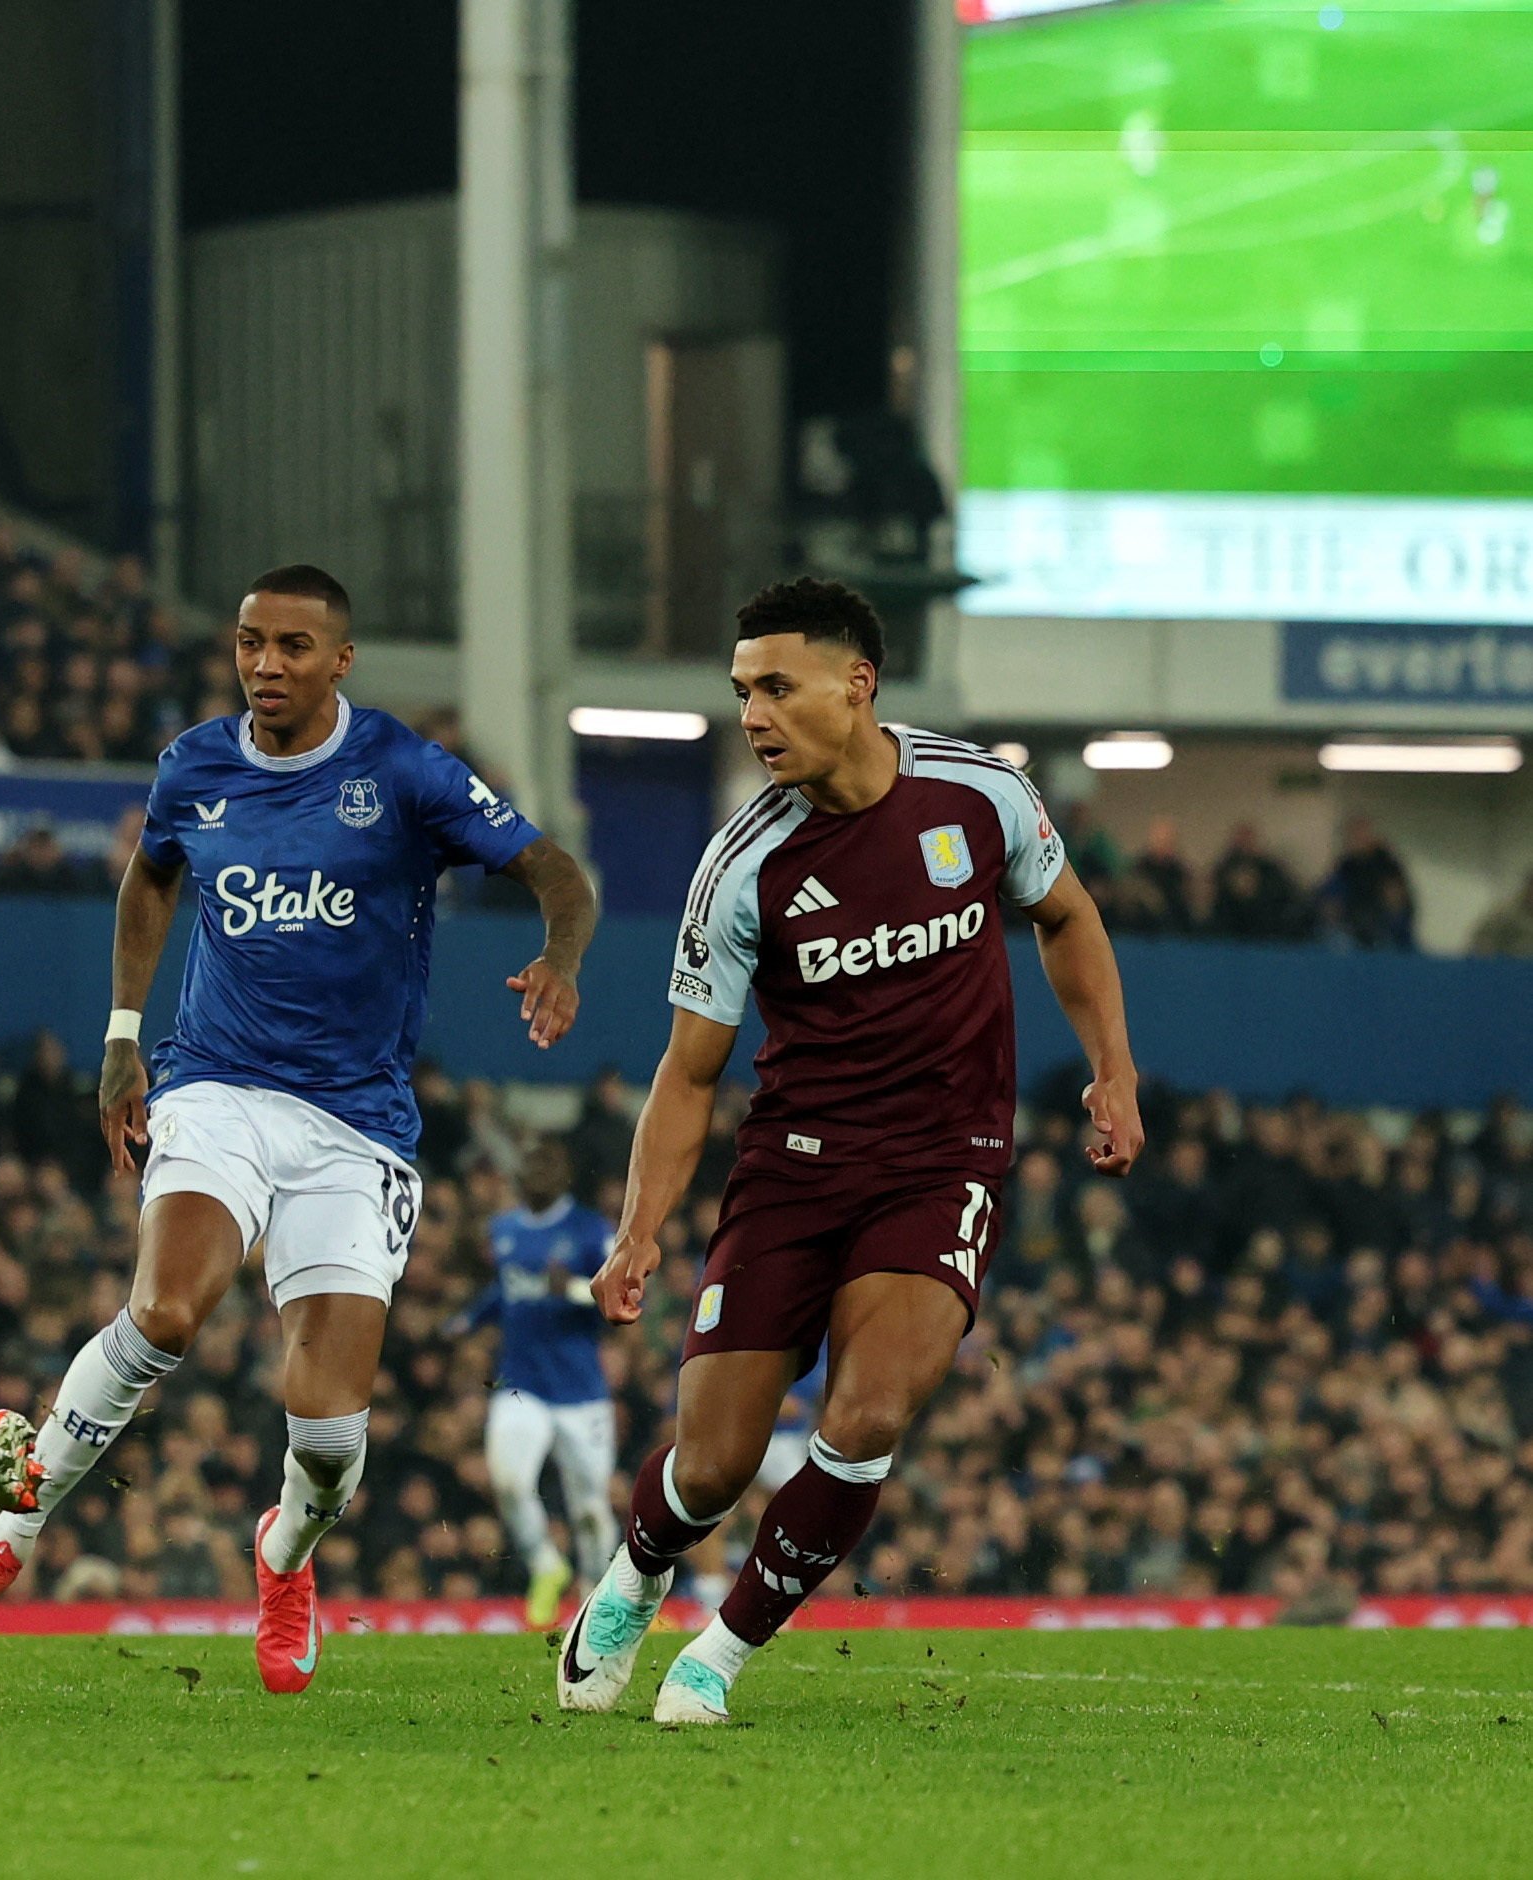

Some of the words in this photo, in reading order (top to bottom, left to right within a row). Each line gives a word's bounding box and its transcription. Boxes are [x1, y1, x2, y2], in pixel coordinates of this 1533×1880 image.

[215, 864, 356, 936] Stake
[275, 922, 304, 932] .com
[797, 902, 985, 984] Betano
[63, 1409, 110, 1448] EFC
